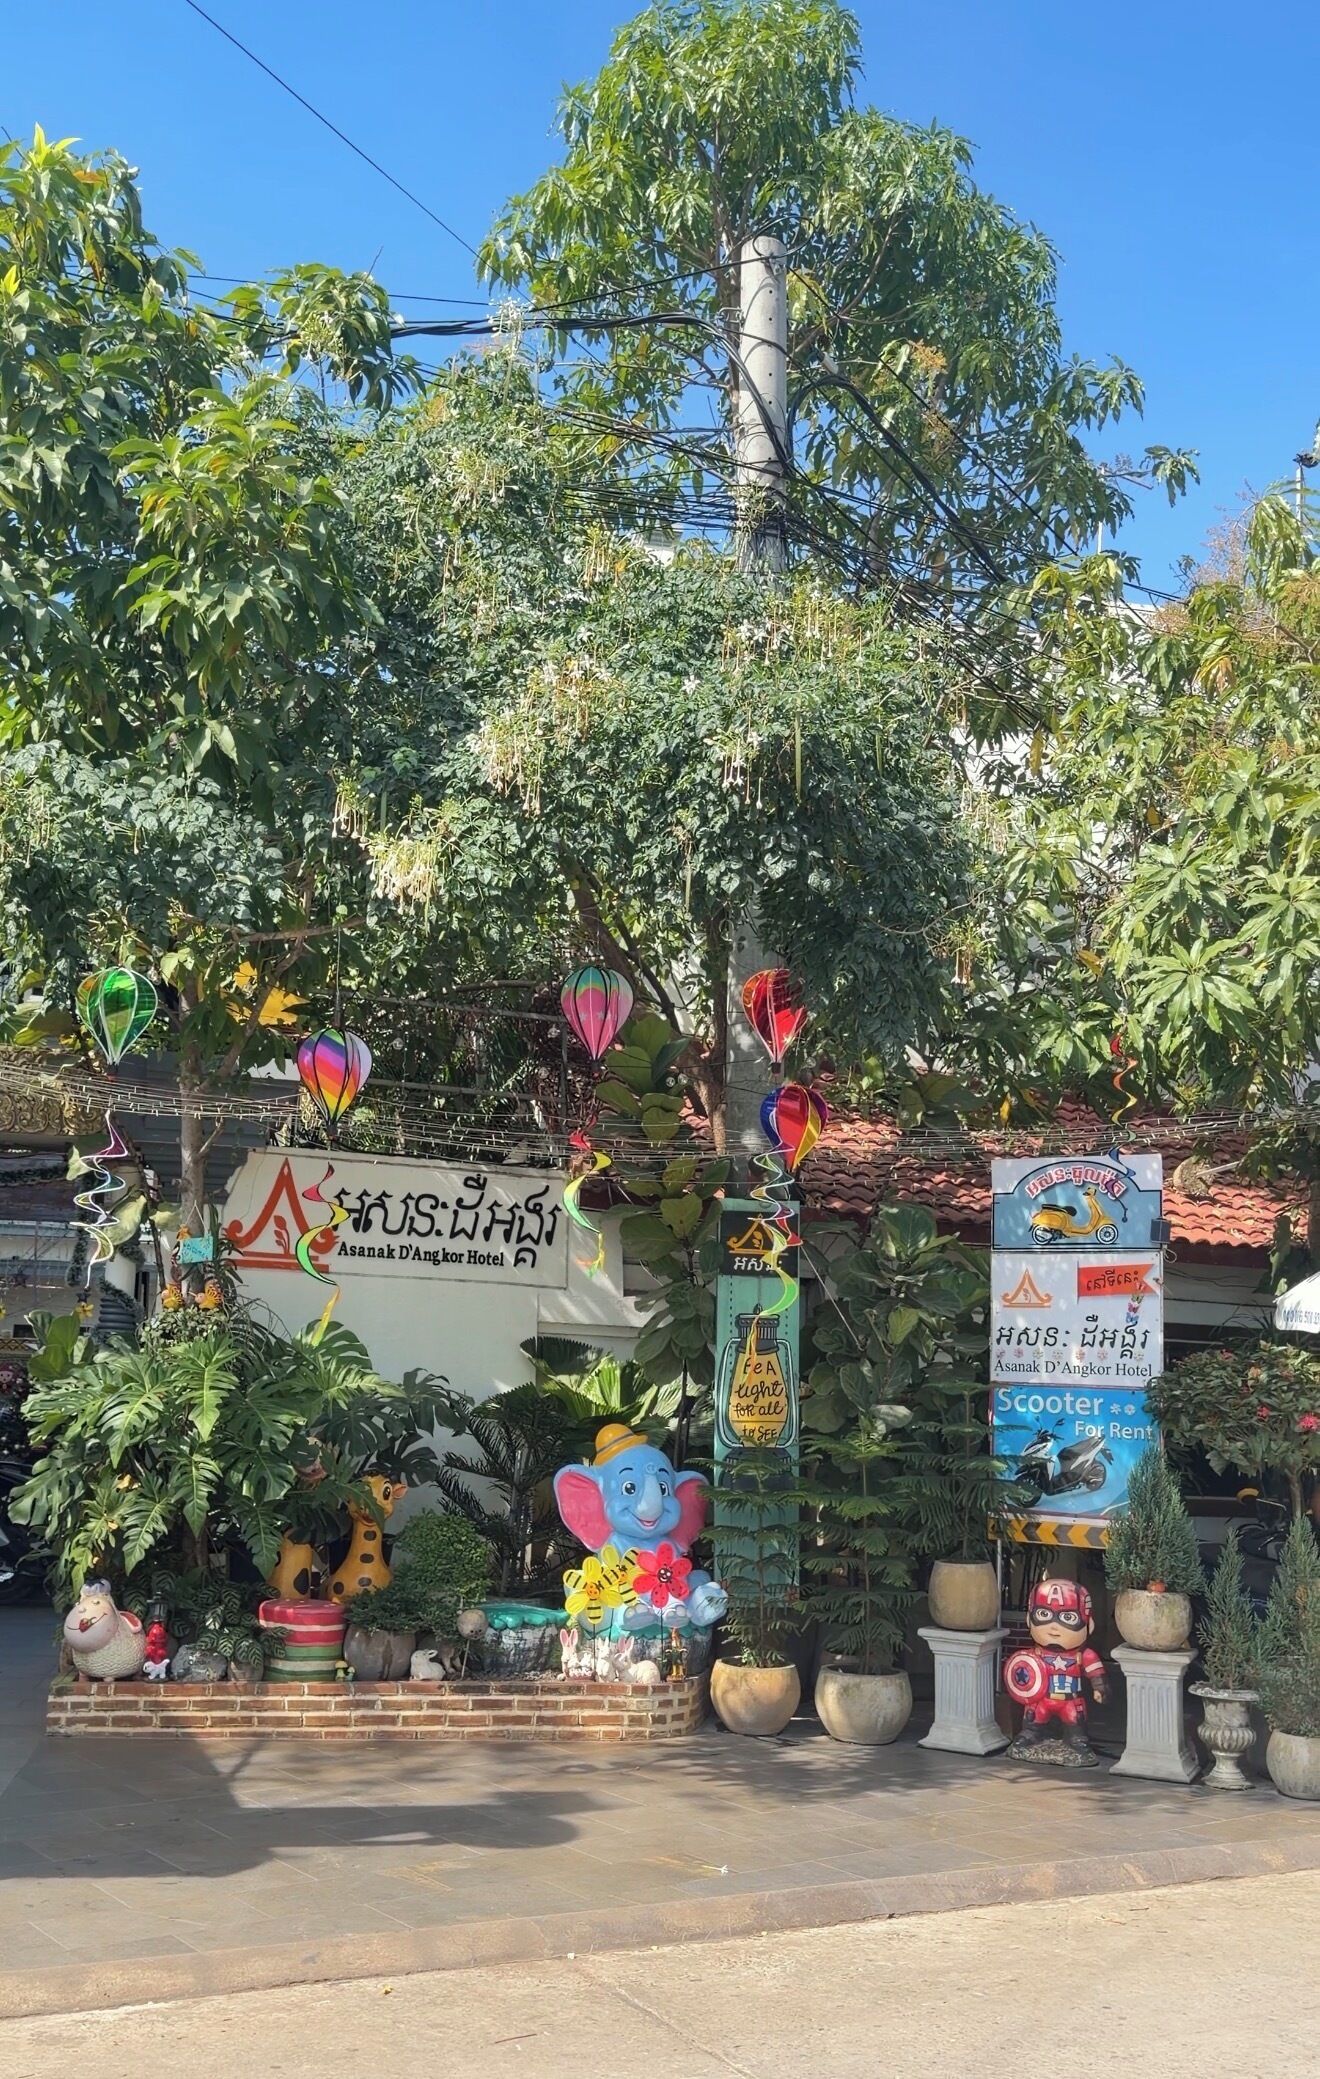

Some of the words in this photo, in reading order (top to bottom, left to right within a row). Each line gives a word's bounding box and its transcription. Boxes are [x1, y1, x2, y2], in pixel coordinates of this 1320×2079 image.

[338, 1241, 396, 1260] Asanak
[399, 1243, 464, 1266] D'Angkor
[466, 1249, 505, 1267] Hotel
[766, 1361, 777, 1375] A
[994, 1360, 1041, 1373] Asanak
[1045, 1361, 1111, 1378] D'Angkor
[1115, 1363, 1152, 1377] Hotel
[758, 1401, 784, 1416] all
[997, 1388, 1104, 1416] Scooter
[1075, 1420, 1105, 1437] For
[1110, 1422, 1152, 1440] Rent
[1047, 1584, 1064, 1606] A
